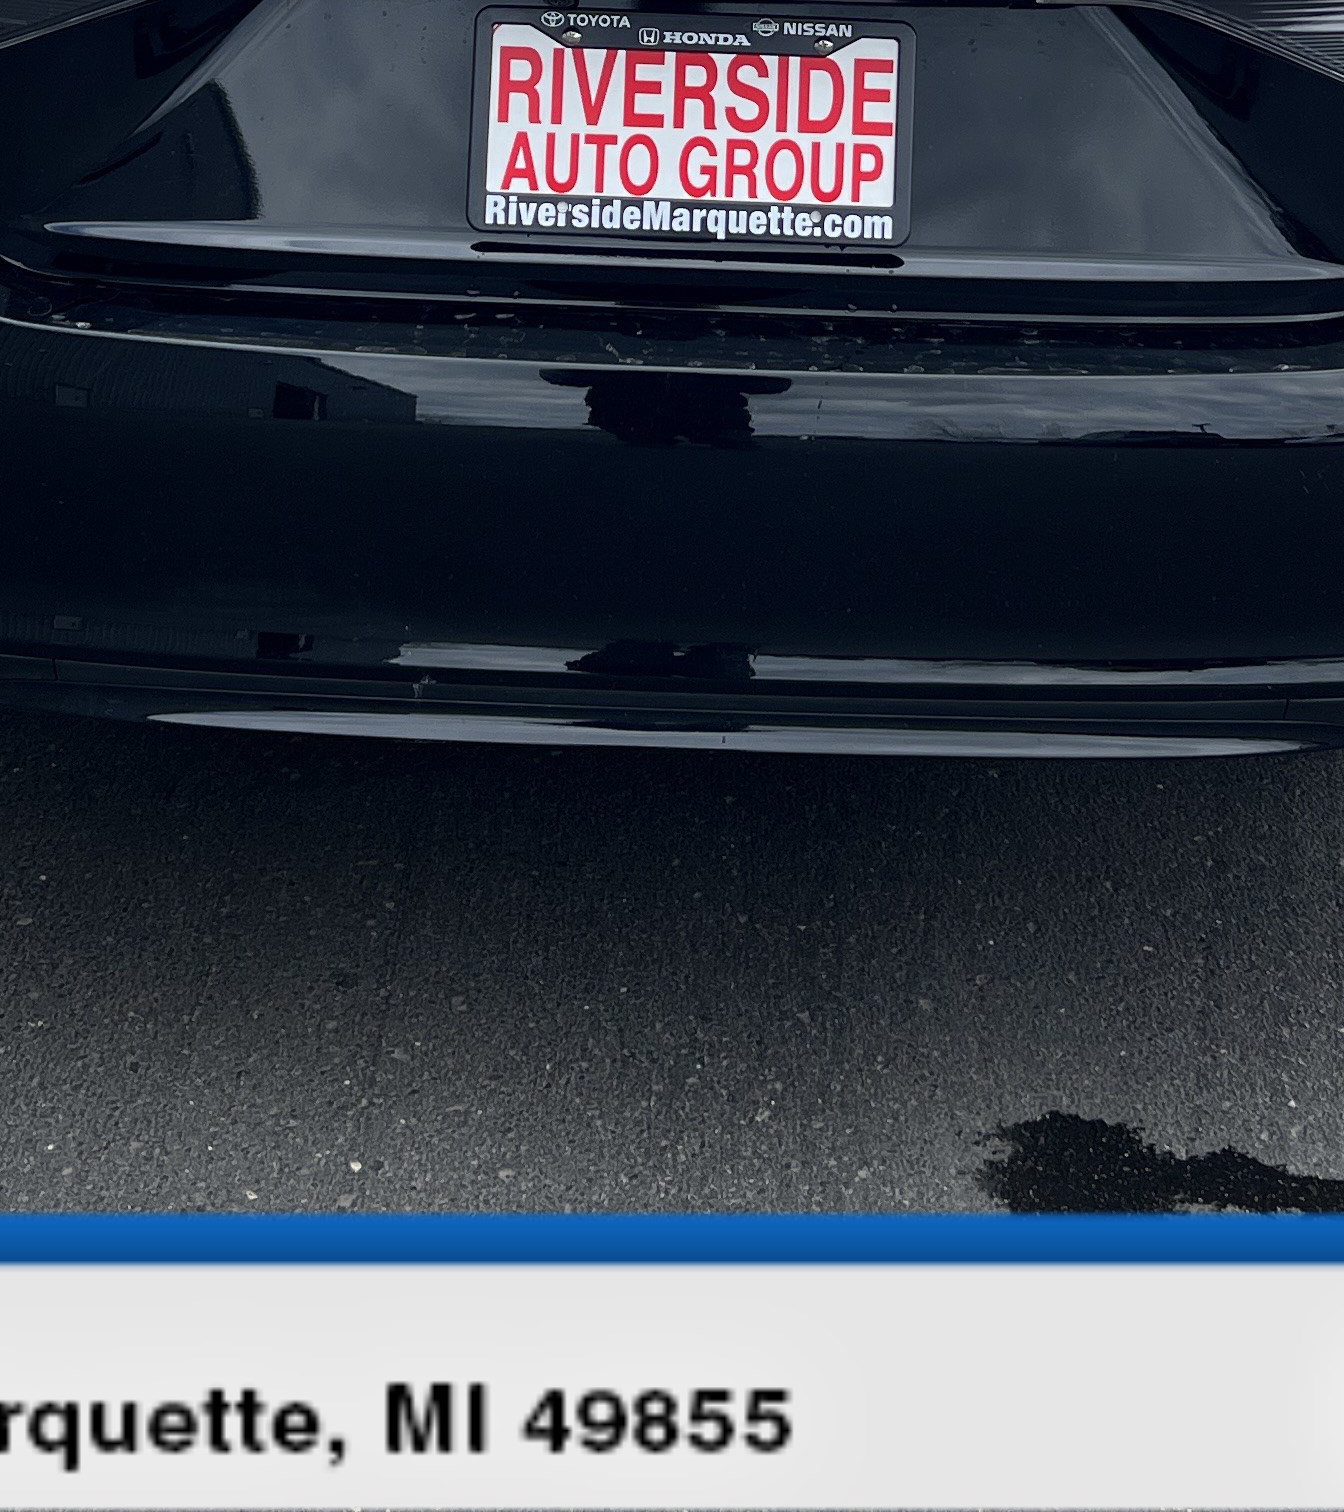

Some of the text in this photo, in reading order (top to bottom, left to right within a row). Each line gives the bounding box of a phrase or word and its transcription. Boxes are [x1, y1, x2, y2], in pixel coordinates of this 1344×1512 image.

[568, 13, 631, 29] TOYOTA
[783, 22, 852, 38] NISSAN
[663, 31, 751, 47] HONDA
[497, 45, 894, 136] RIVERSIDE
[501, 131, 885, 203] AUTO GROUP
[484, 195, 893, 240] RiversideMarquette.com
